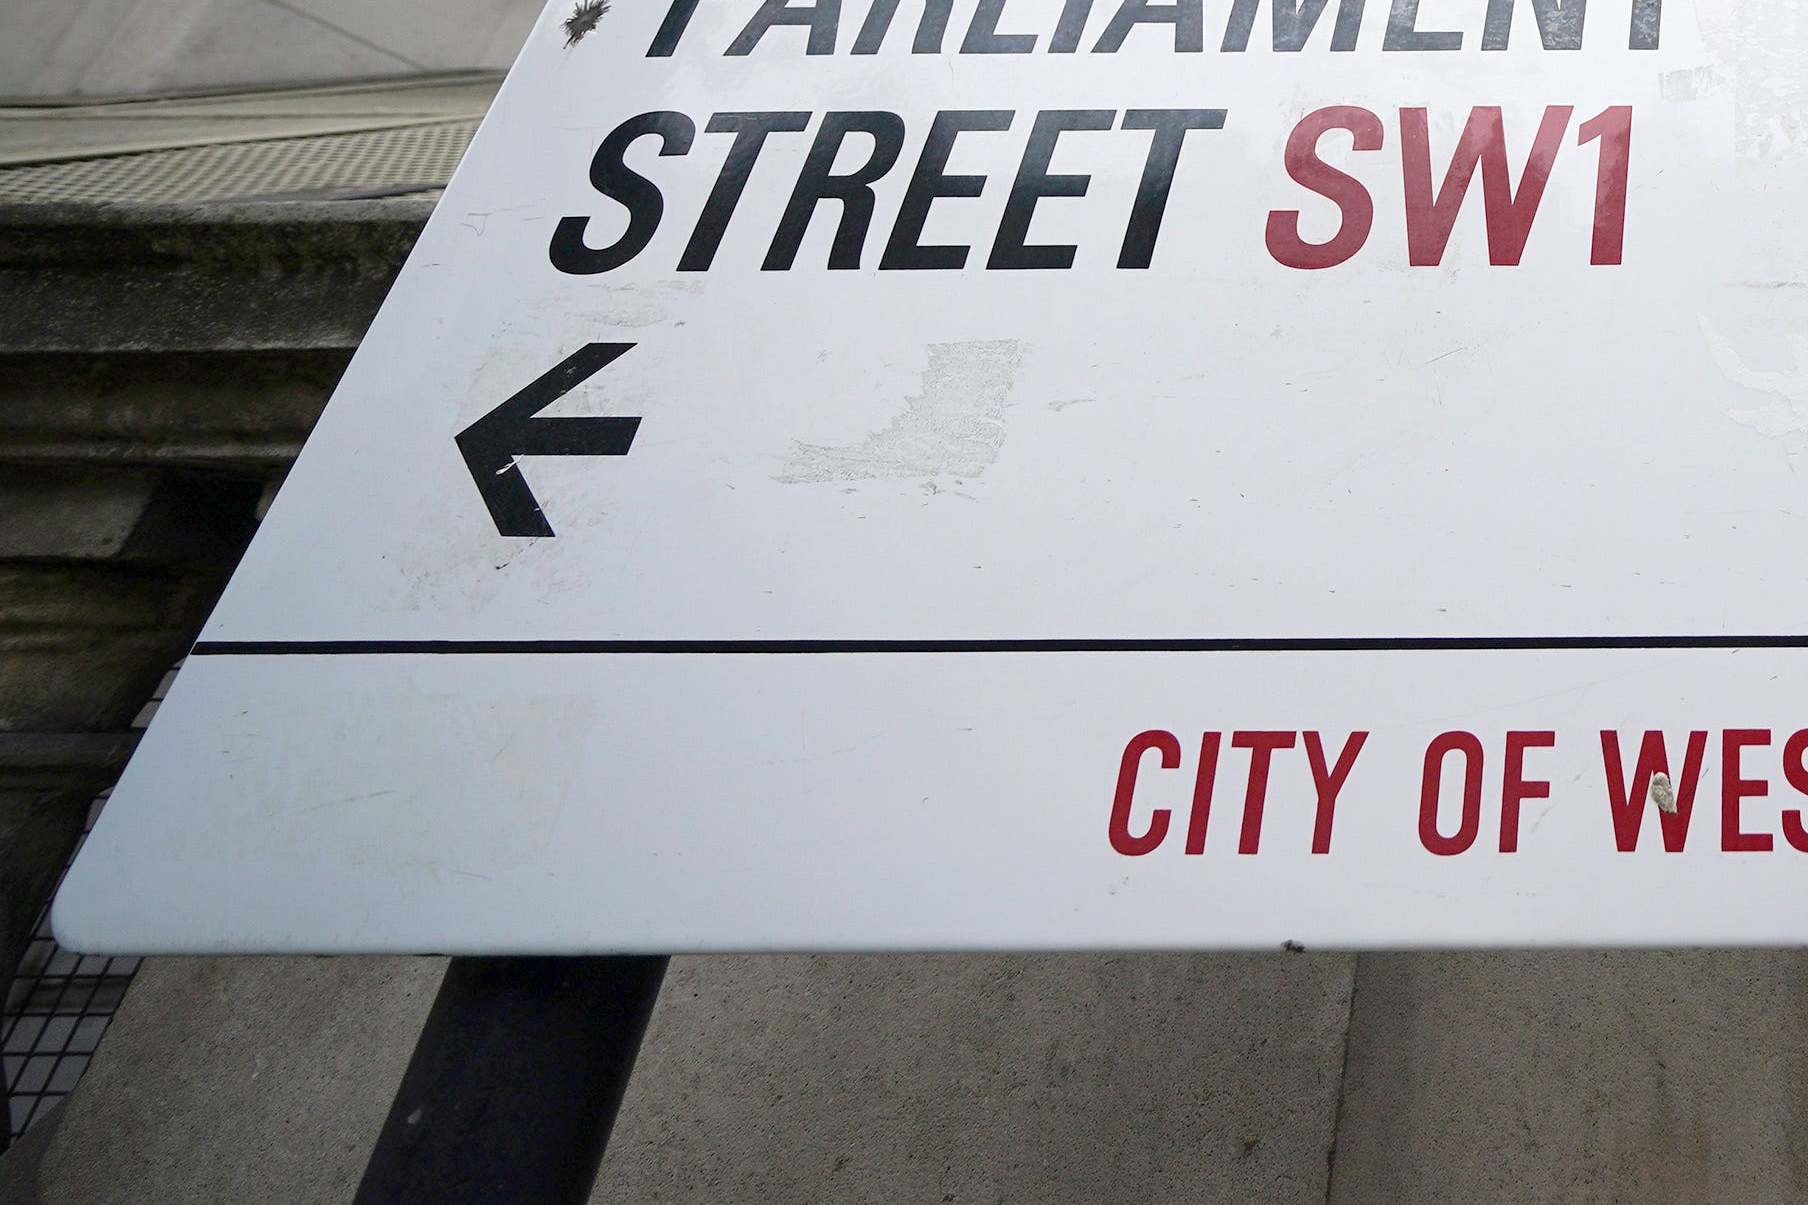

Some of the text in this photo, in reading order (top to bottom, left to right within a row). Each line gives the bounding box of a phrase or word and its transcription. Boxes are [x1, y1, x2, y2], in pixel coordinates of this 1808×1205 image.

[548, 105, 1632, 276] STREET SW1
[1108, 729, 1370, 857] CITY
[1418, 729, 1556, 857] OF
